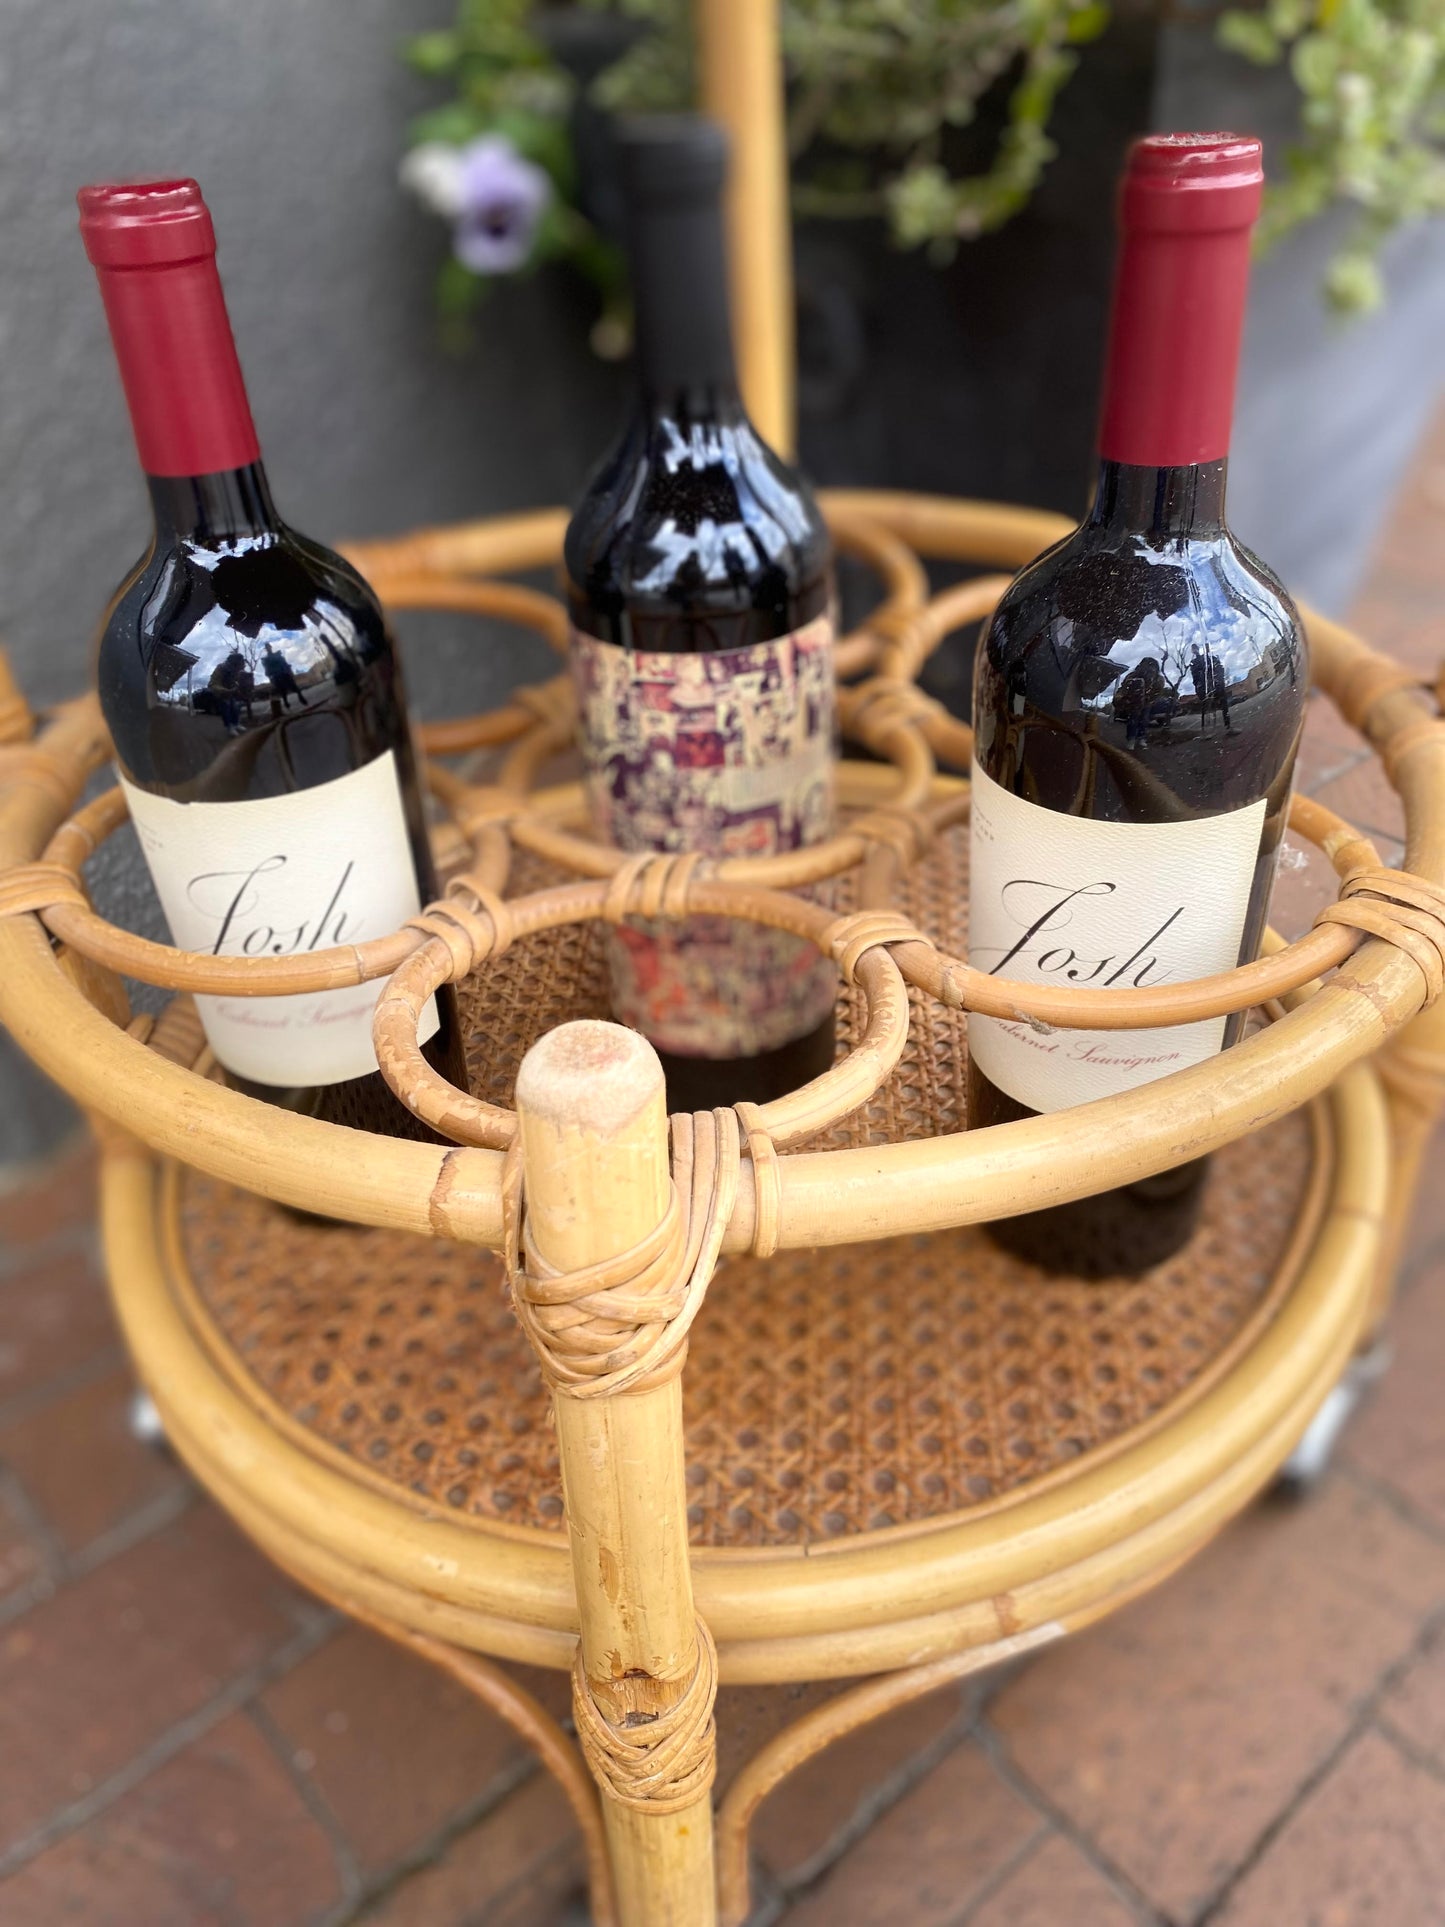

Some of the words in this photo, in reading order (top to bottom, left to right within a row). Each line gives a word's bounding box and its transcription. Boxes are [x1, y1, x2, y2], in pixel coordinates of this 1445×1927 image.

[187, 855, 365, 955] Josh
[971, 879, 1185, 988] Josh
[992, 1018, 1060, 1053] abernet
[1066, 1040, 1182, 1072] Sauvignon
